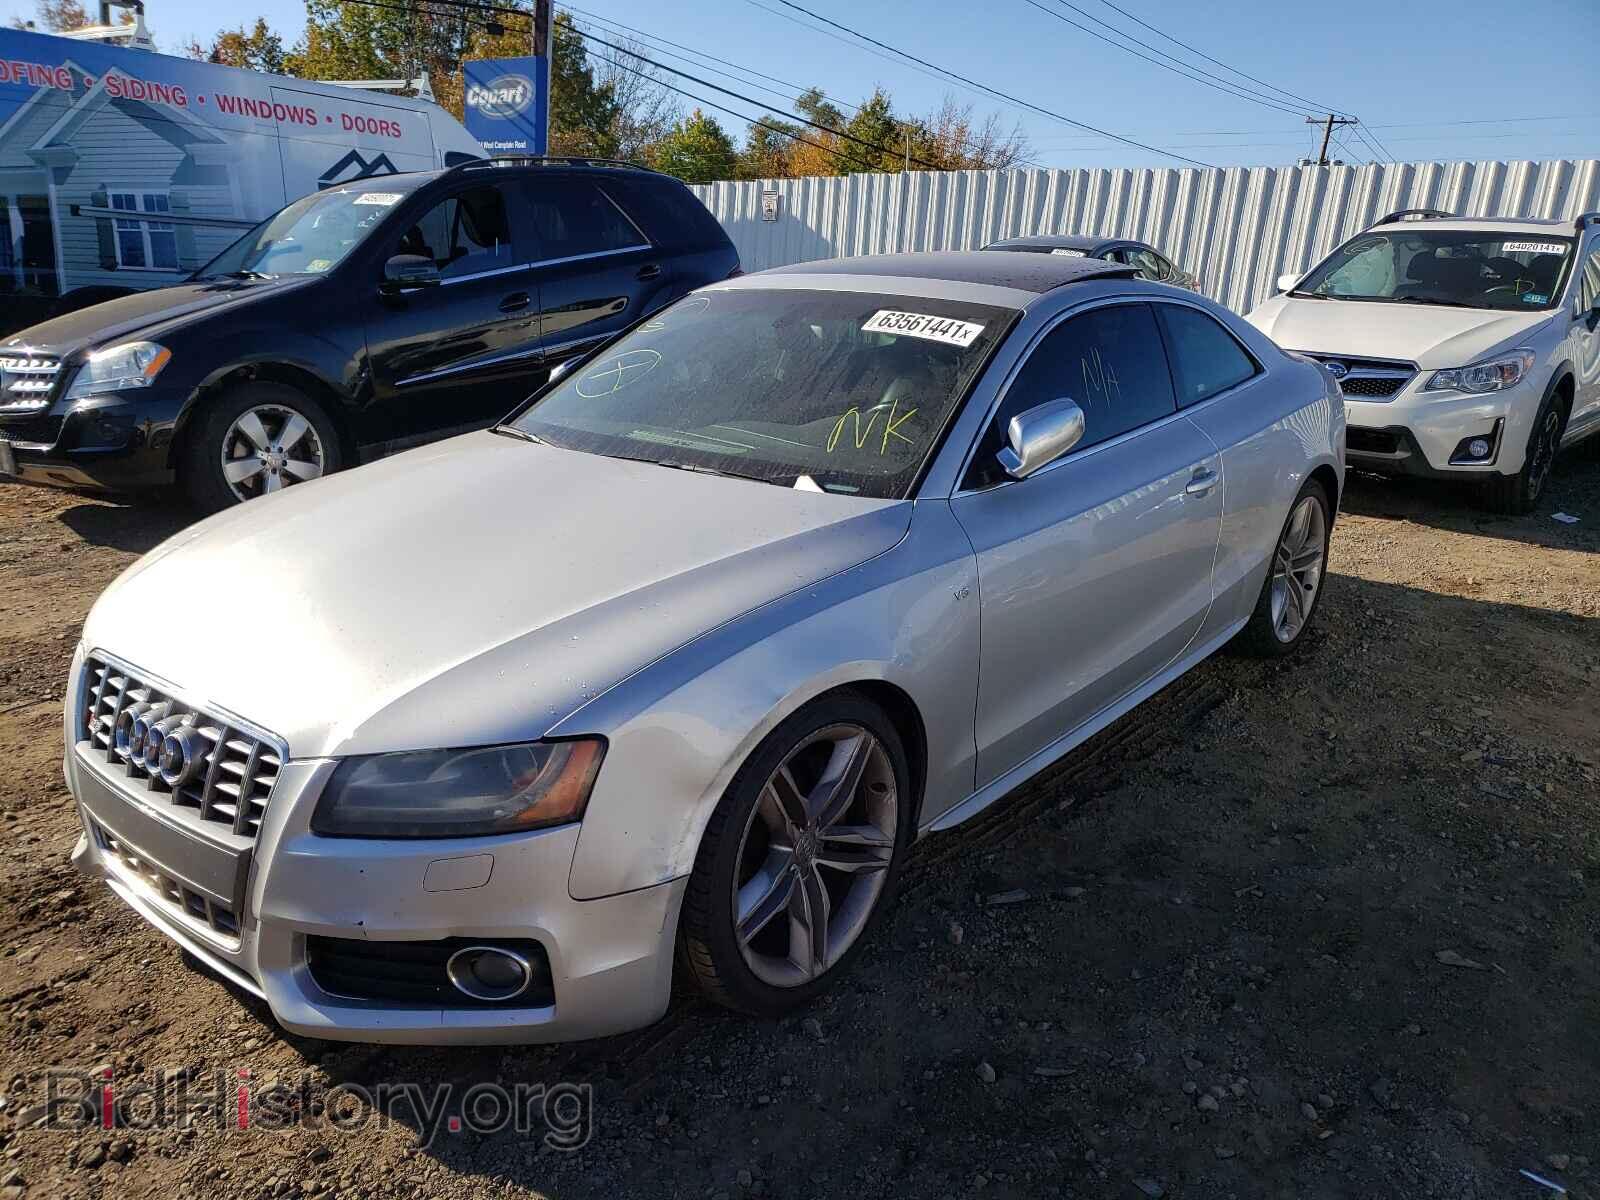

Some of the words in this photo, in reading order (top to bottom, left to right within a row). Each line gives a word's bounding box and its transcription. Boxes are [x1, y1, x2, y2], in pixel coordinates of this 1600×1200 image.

[105, 72, 187, 107] SIDING
[215, 94, 318, 126] WINDOWS
[341, 112, 402, 138] DOORS
[467, 82, 525, 110] Copart
[827, 400, 919, 456] NK
